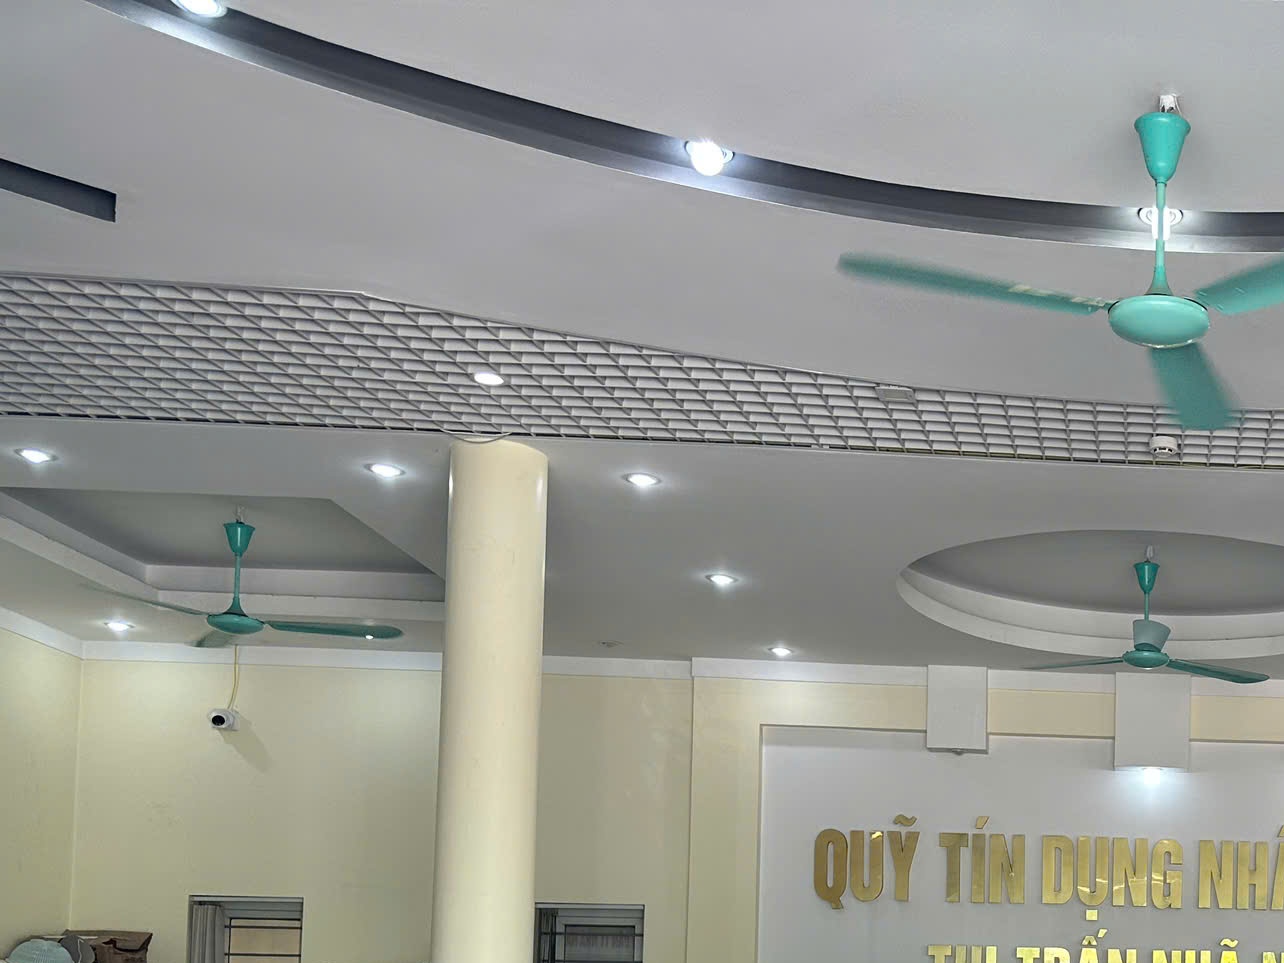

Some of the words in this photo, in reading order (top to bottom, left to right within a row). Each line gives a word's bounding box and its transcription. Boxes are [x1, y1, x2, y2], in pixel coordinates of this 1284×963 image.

[813, 814, 920, 909] QUỸ
[939, 816, 1025, 904] TÍN
[1042, 835, 1184, 921] DỤNG
